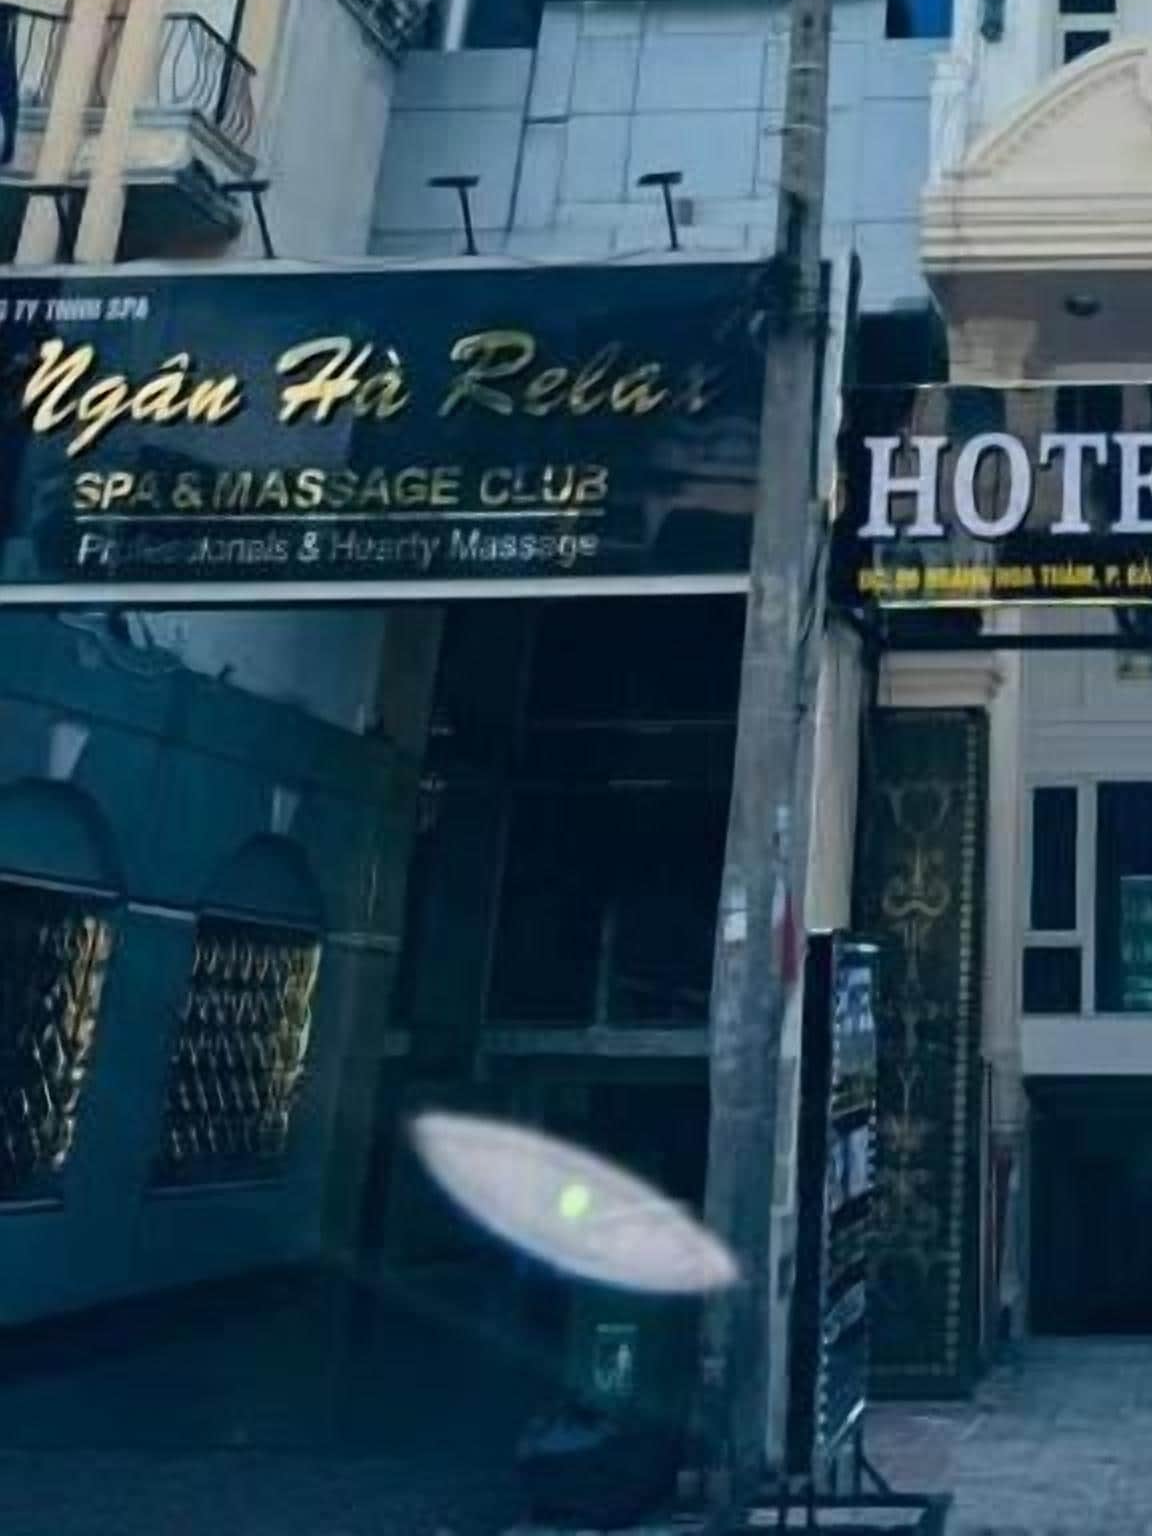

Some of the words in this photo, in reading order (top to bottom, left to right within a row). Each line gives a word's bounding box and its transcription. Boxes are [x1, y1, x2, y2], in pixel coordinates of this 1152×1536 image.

[21, 339, 243, 455] Ngân
[277, 336, 408, 422] Hà
[73, 471, 161, 510] SPA
[211, 466, 462, 509] MASSAGE
[480, 464, 608, 505] CLUB
